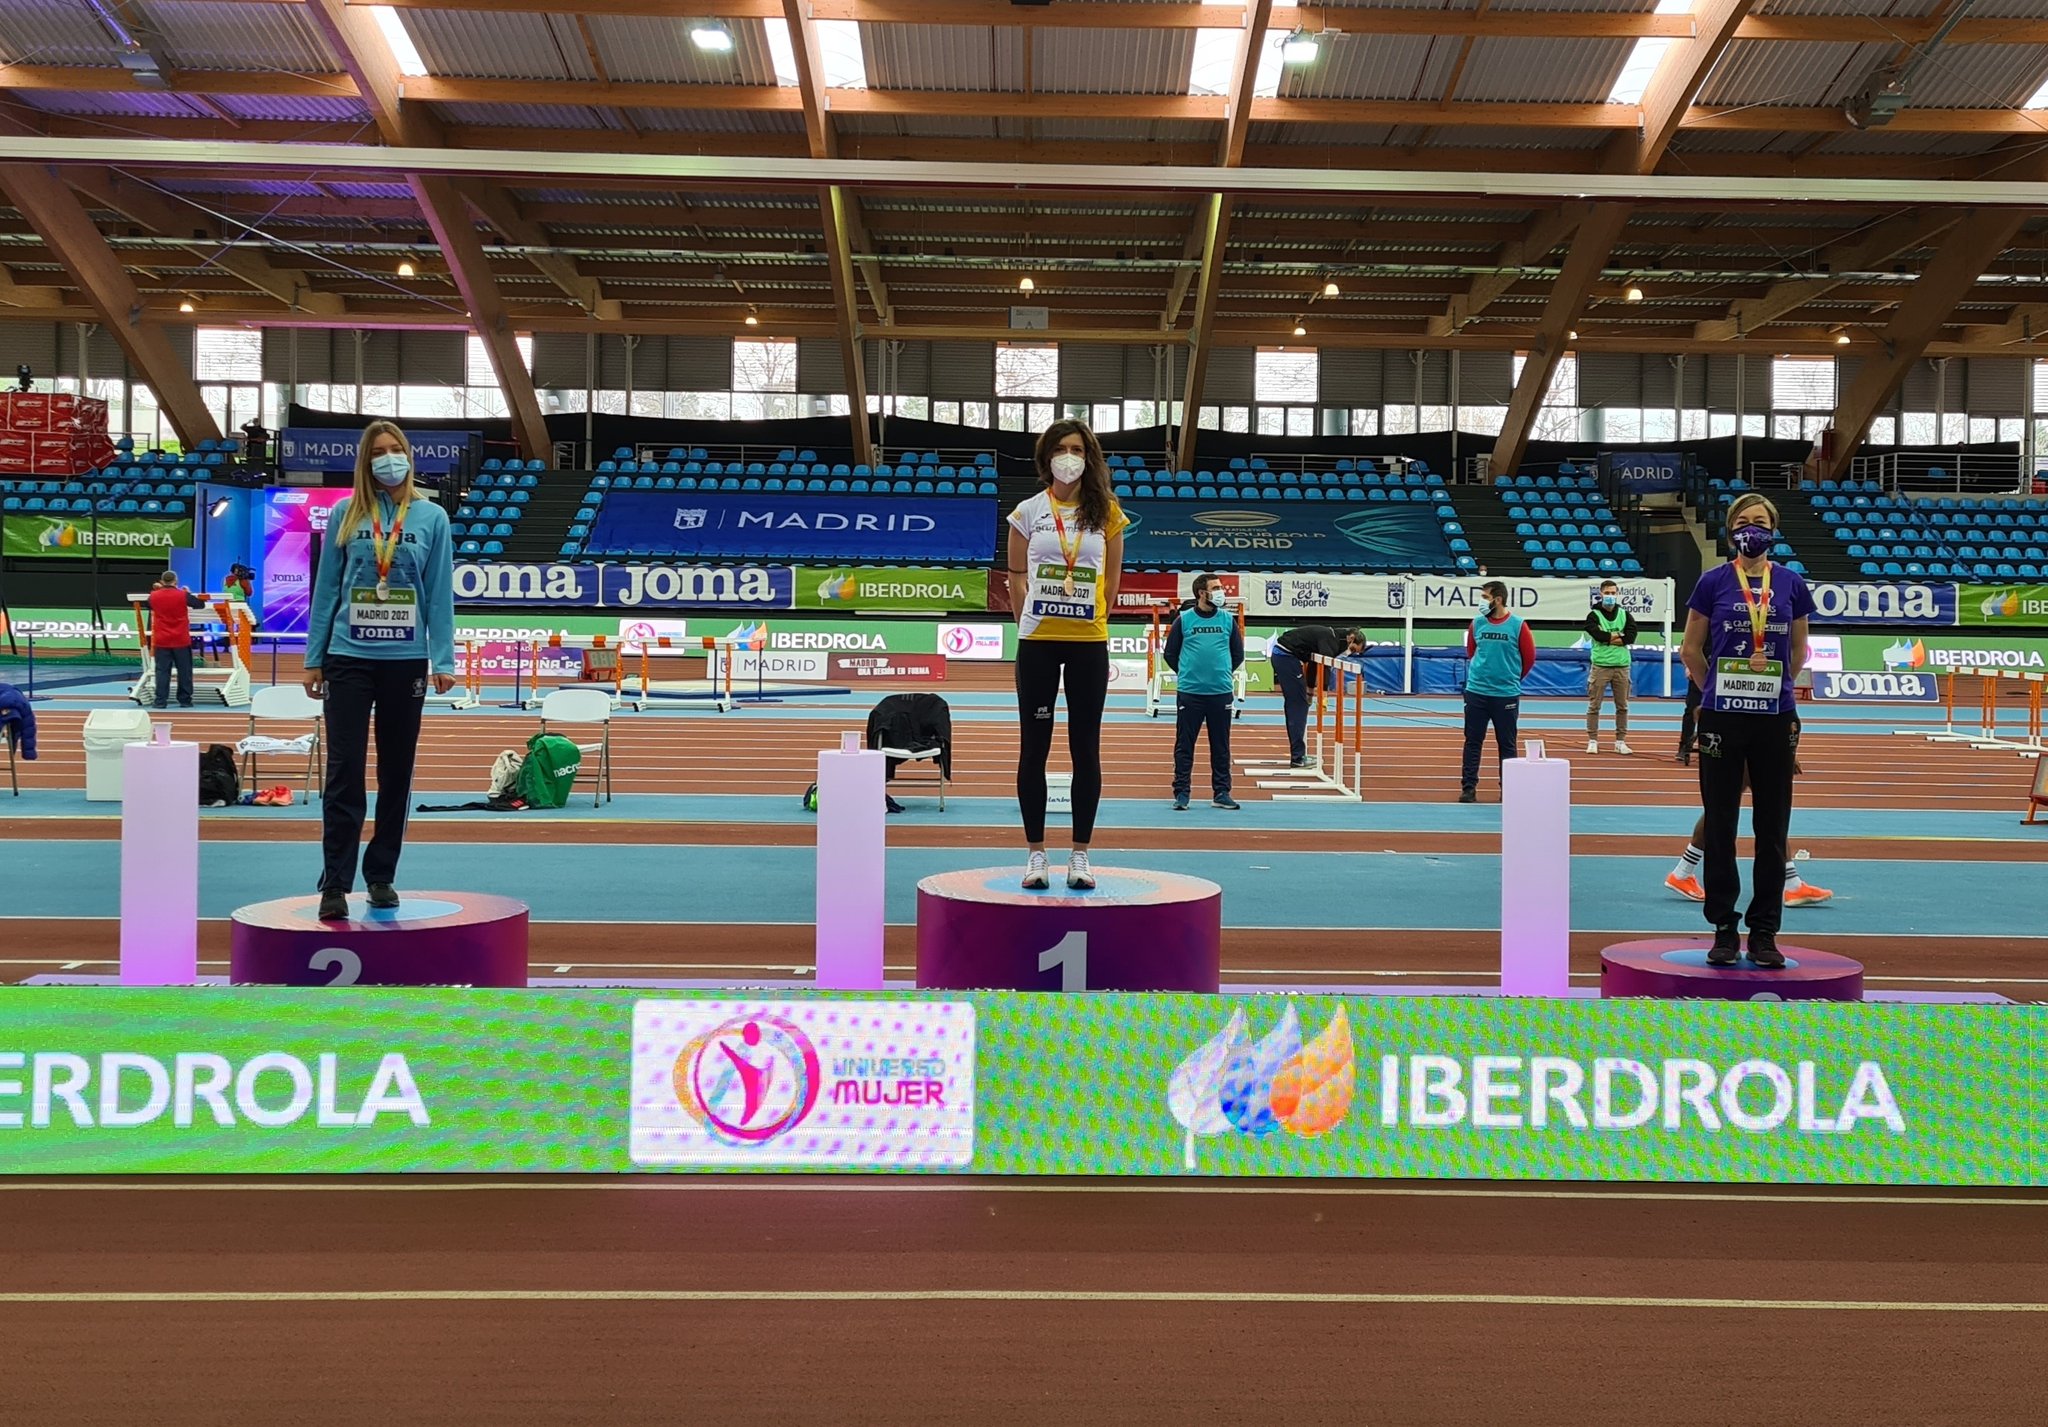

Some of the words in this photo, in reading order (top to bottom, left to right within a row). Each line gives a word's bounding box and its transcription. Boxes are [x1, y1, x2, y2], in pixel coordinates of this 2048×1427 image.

[1621, 466, 1674, 480] ADRID
[738, 511, 936, 532] MADRID
[77, 532, 174, 546] IBERDROLA
[1191, 537, 1293, 549] MADRID
[452, 564, 582, 599] oma
[618, 565, 775, 605] Joma
[1292, 580, 1322, 590] Madrid
[859, 583, 965, 599] IBERDROLA
[1073, 588, 1090, 599] 2021
[1297, 589, 1314, 599] es
[1425, 586, 1539, 608] MADID
[1291, 599, 1328, 608] Deporte
[1807, 583, 1940, 618] oma
[357, 609, 389, 620] MADRID
[391, 610, 409, 621] 2021
[1622, 605, 1652, 614] eporte
[771, 633, 887, 650] IBERDROLA
[743, 659, 817, 672] MADRID
[849, 659, 878, 667] MADRID
[1929, 649, 2045, 667] IBERDROLA
[1723, 680, 1755, 691] MADRID
[1757, 682, 1774, 692] 2021
[1824, 673, 1925, 697] Joma
[308, 947, 362, 987] 2
[1038, 931, 1087, 992] 1
[834, 1079, 945, 1105] MUJER
[1380, 1053, 1907, 1133] IBERDROLA
